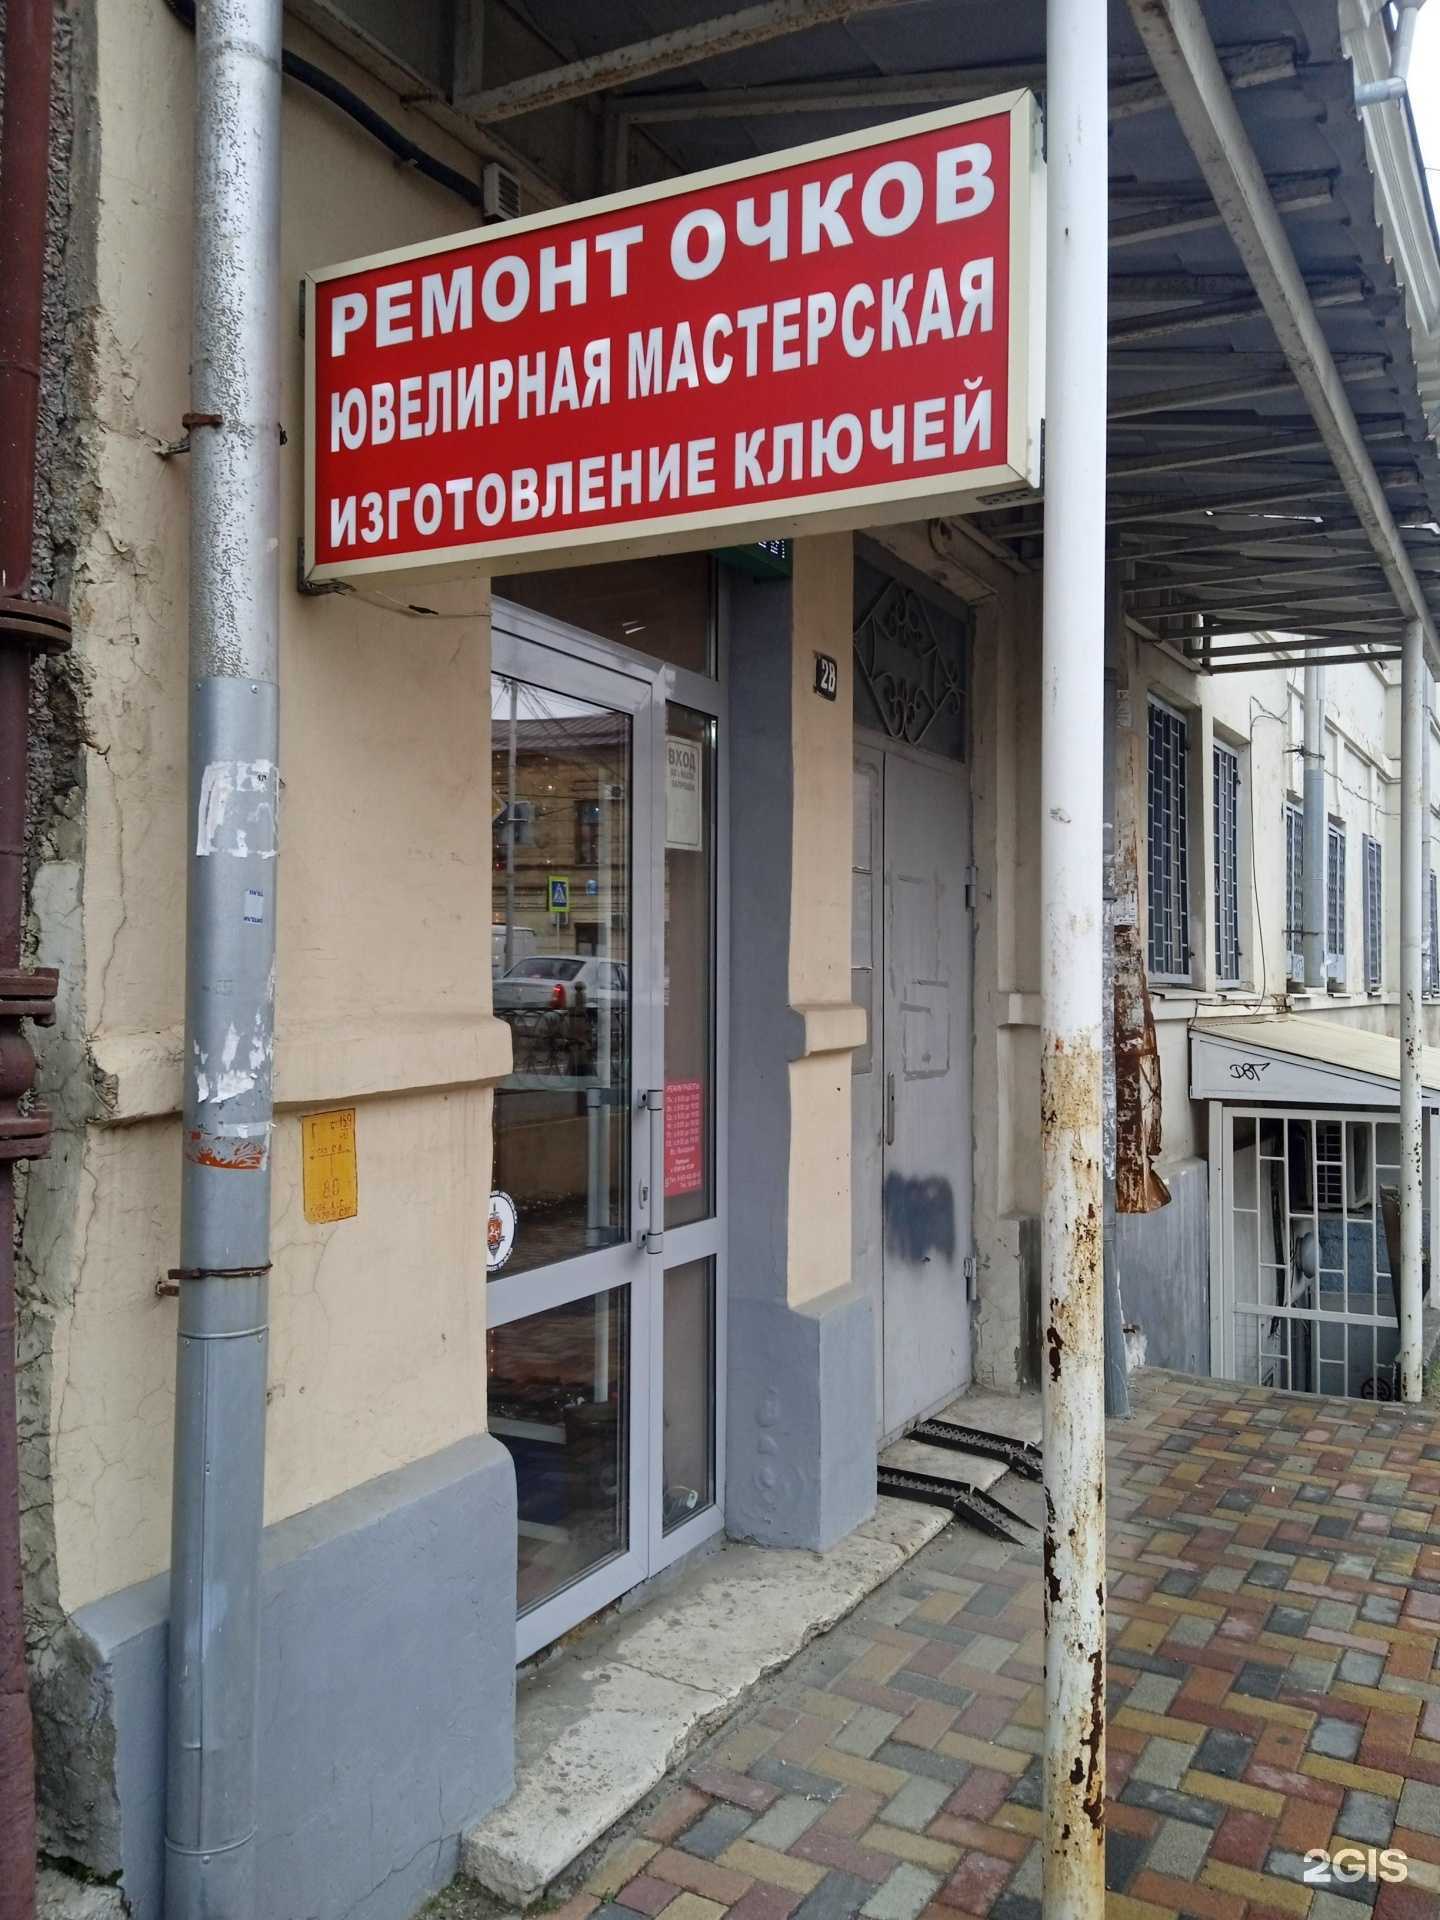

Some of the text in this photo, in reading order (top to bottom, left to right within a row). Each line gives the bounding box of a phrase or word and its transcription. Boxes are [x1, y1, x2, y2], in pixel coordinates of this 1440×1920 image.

[331, 143, 994, 358] РЕМОНТ ОЧКОВ
[331, 257, 994, 452] ЮВЕЛИРНАЯ МАСТЕРСКАЯ
[330, 376, 992, 547] ИЗГОТОВЛЕНИЕ КЛЮЧЕЙ
[668, 747, 696, 772] ВХОД
